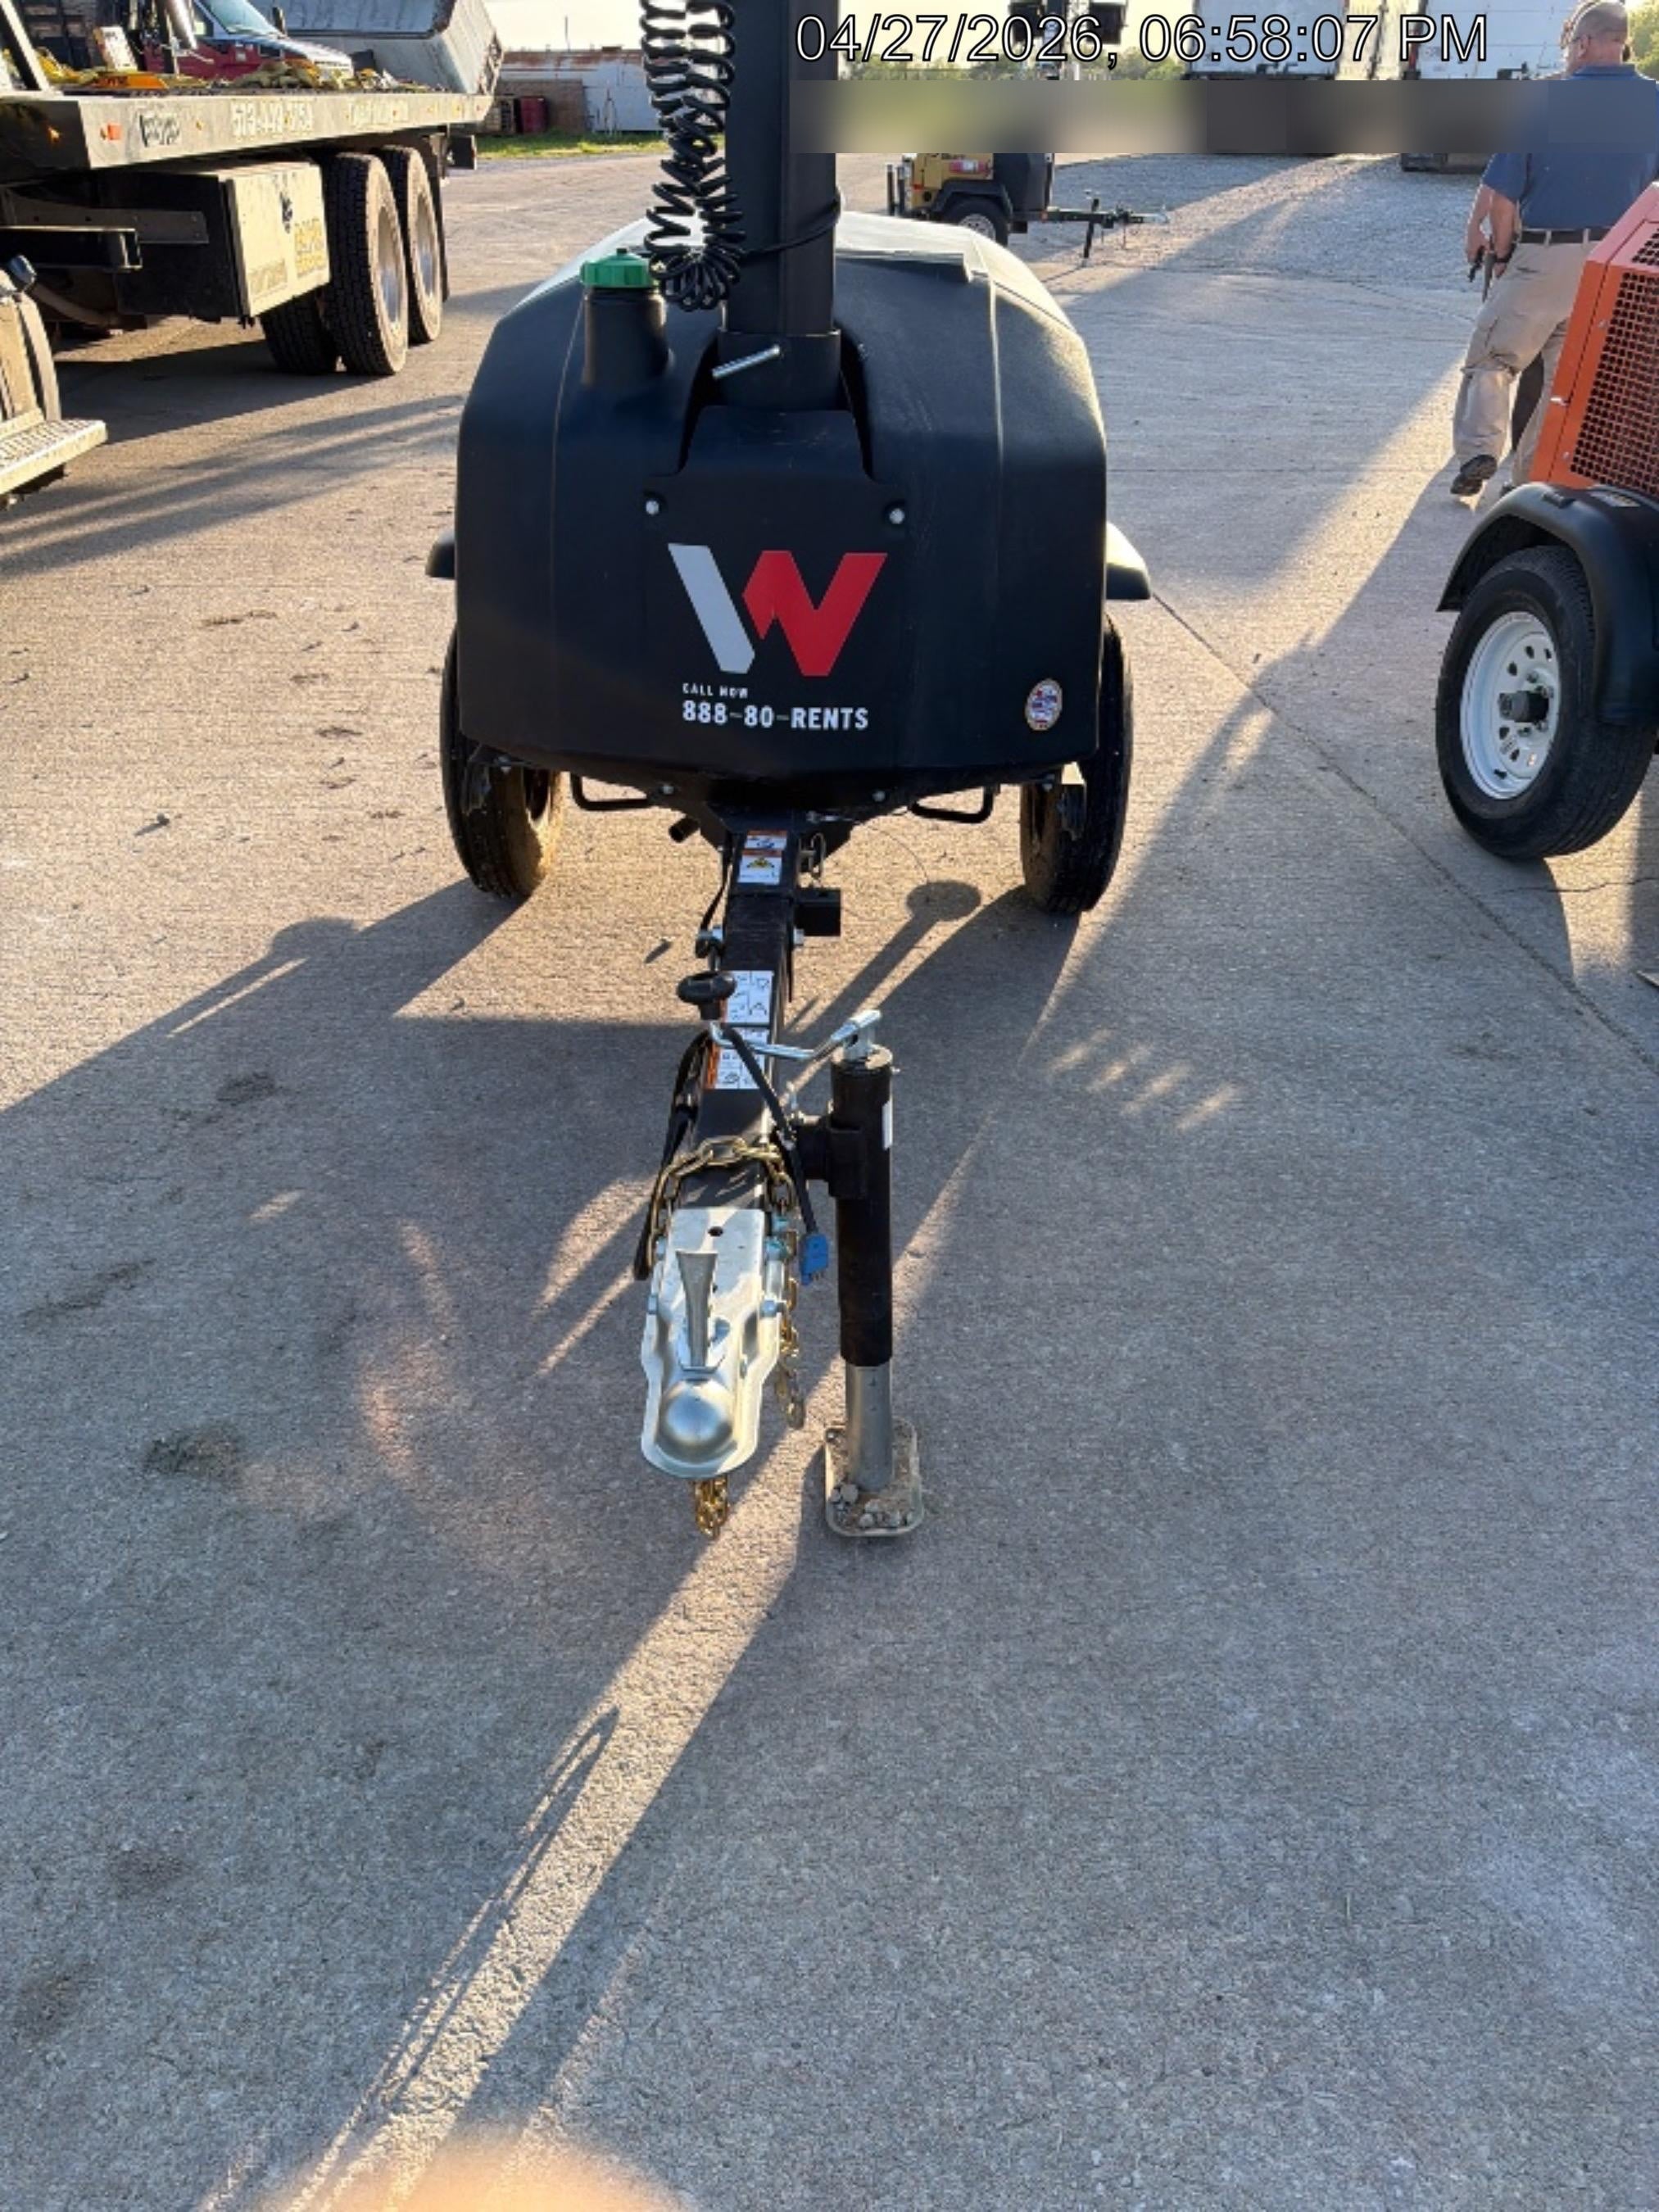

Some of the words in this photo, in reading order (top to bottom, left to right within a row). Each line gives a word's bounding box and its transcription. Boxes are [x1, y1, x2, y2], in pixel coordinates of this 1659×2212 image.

[682, 682, 714, 696] CALL
[719, 685, 748, 698] NOW
[682, 700, 868, 731] 888-80-RENTS
